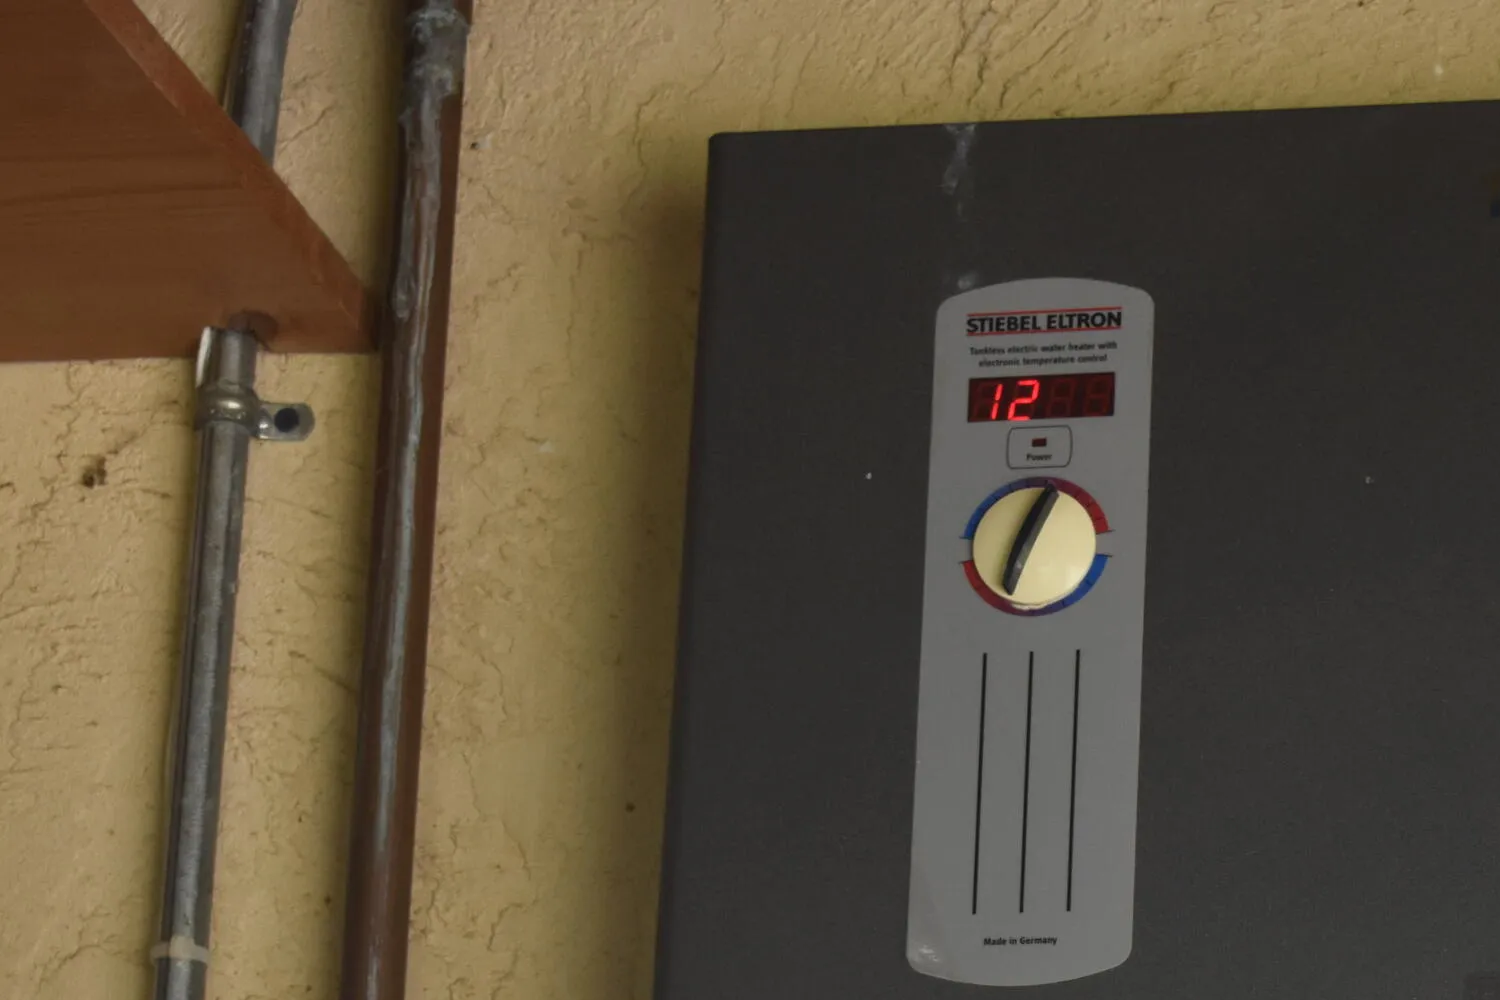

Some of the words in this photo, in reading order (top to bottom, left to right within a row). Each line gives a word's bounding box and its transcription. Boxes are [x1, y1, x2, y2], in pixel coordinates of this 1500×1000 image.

[966, 315, 1041, 333] STIEBEL
[1046, 311, 1122, 330] ELTRON
[970, 346, 1006, 355] Tankless
[1007, 345, 1038, 354] electric
[1040, 344, 1066, 353] water
[1068, 342, 1096, 351] heater
[1097, 340, 1118, 350] with
[979, 357, 1020, 367] electronic
[1023, 355, 1075, 366] temperature
[1077, 353, 1108, 363] control
[989, 379, 1041, 422] 12
[1026, 453, 1053, 462] Power
[983, 937, 1007, 946] Made
[1008, 936, 1018, 945] in
[1019, 936, 1058, 946] Germany
